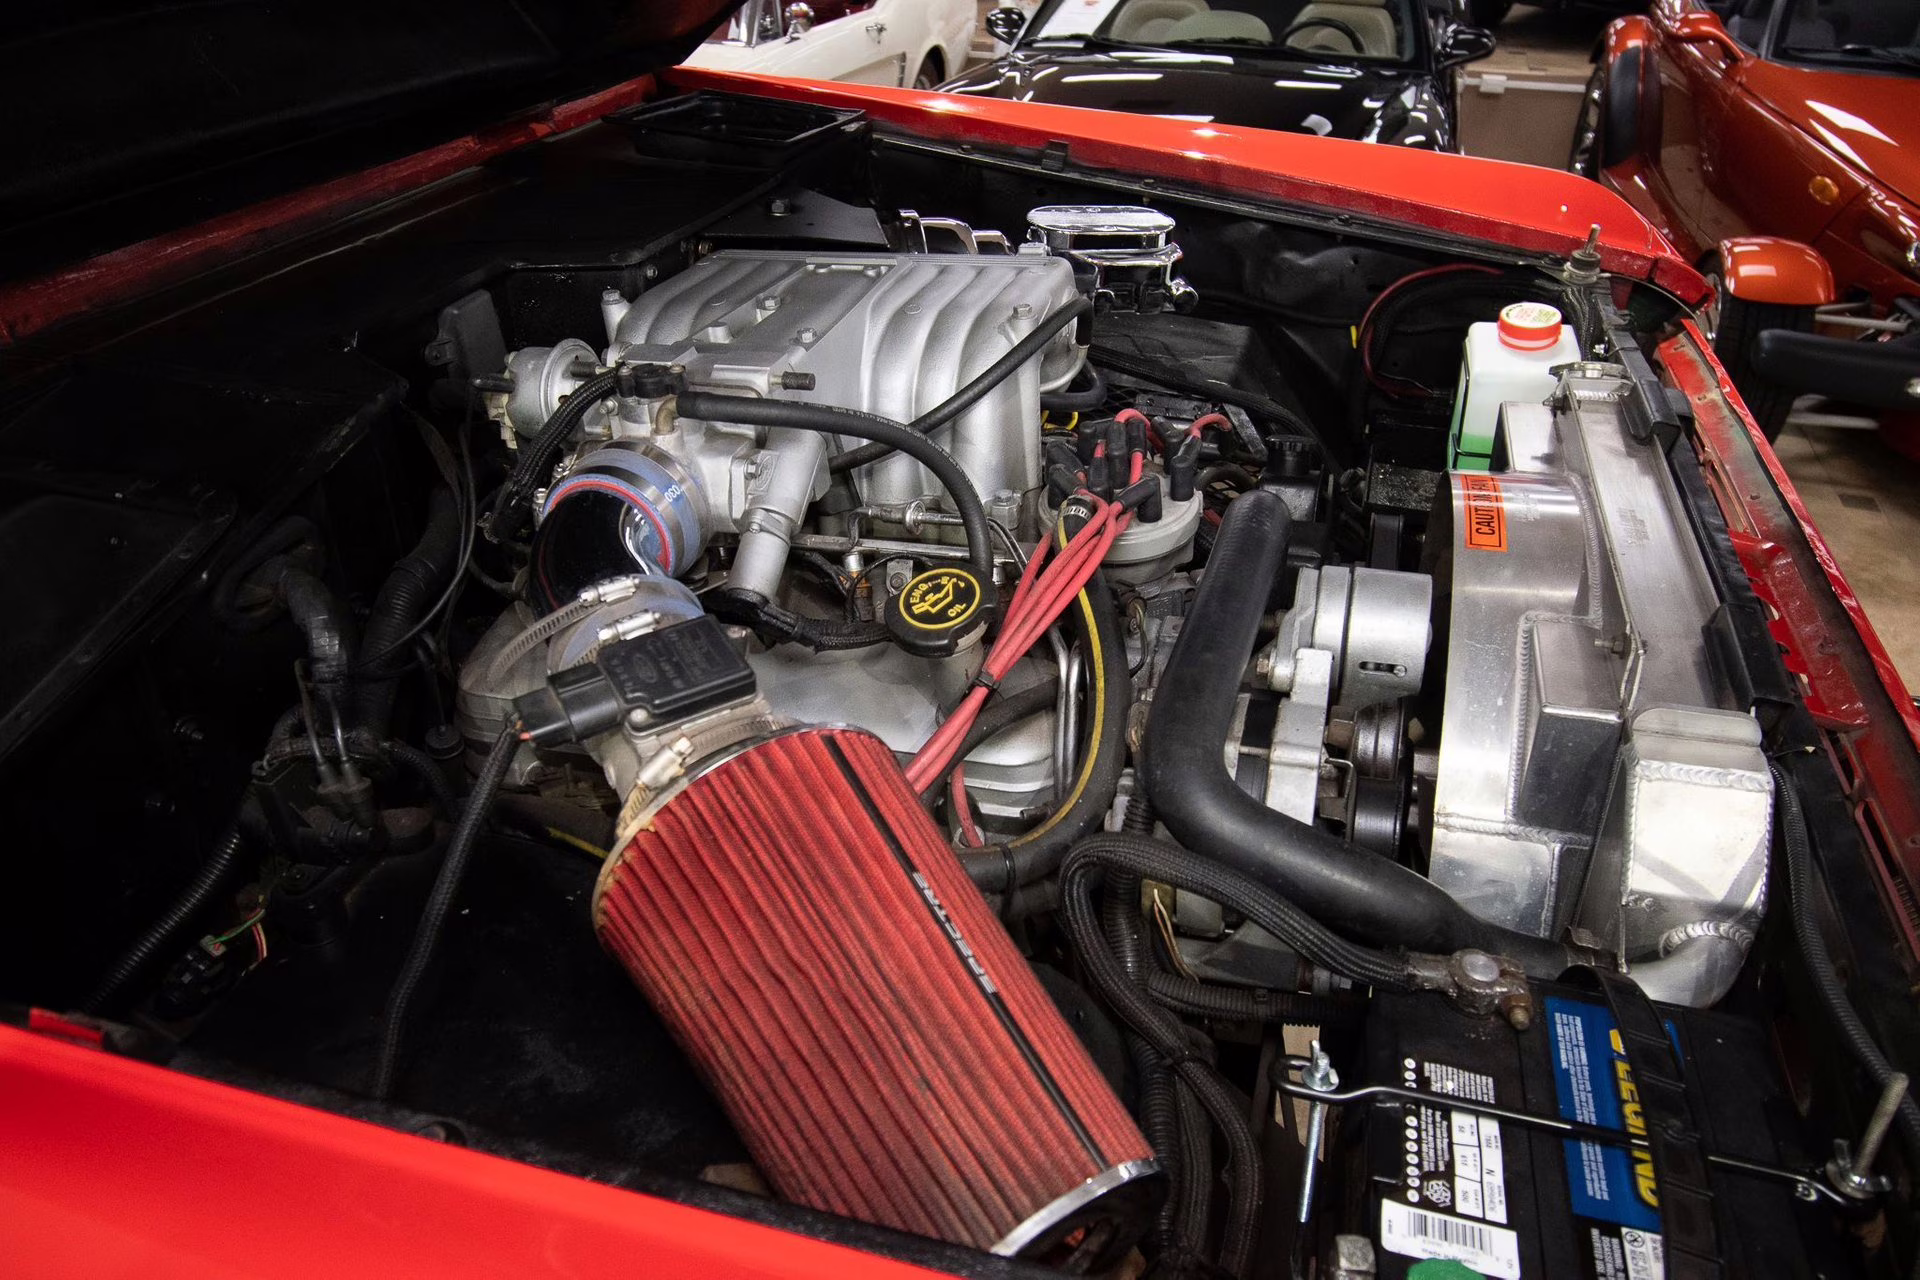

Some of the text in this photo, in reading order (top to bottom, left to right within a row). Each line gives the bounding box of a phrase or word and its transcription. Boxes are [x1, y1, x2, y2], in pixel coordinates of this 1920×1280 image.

[947, 603, 967, 617] OIL
[912, 871, 997, 994] SPECTRE
[1615, 1060, 1659, 1207] LEGND
